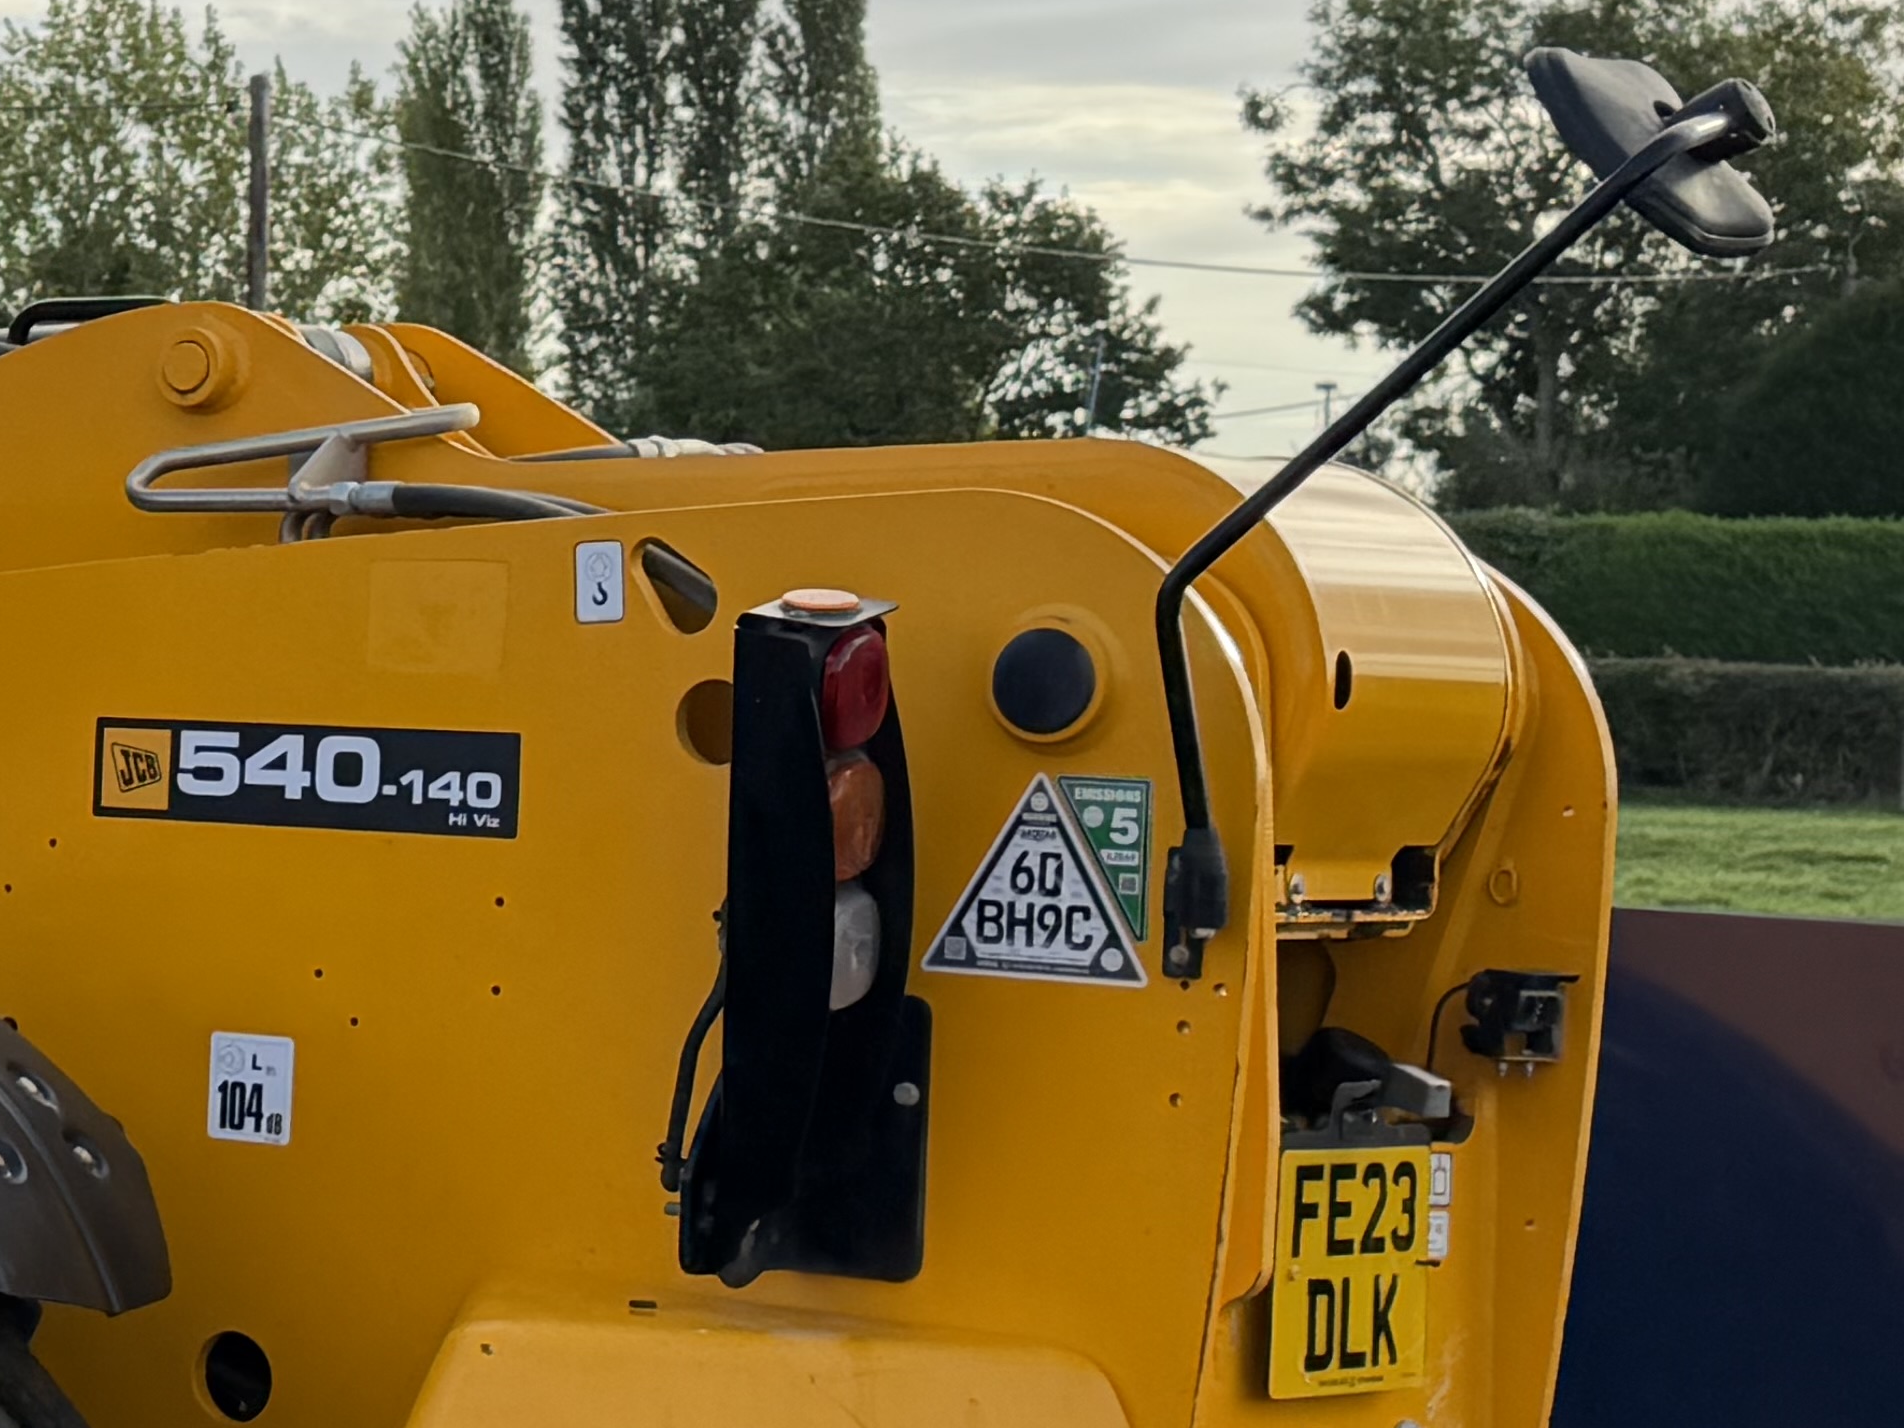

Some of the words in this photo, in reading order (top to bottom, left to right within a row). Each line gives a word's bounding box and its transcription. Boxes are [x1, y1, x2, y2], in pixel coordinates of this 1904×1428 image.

[119, 749, 158, 787] JCB
[473, 813, 500, 828] Viz
[1108, 807, 1140, 845] 5
[976, 899, 1093, 951] BH9C
[217, 1079, 264, 1133] 104
[1292, 1160, 1417, 1259] FE23
[1304, 1273, 1399, 1373] DLK
